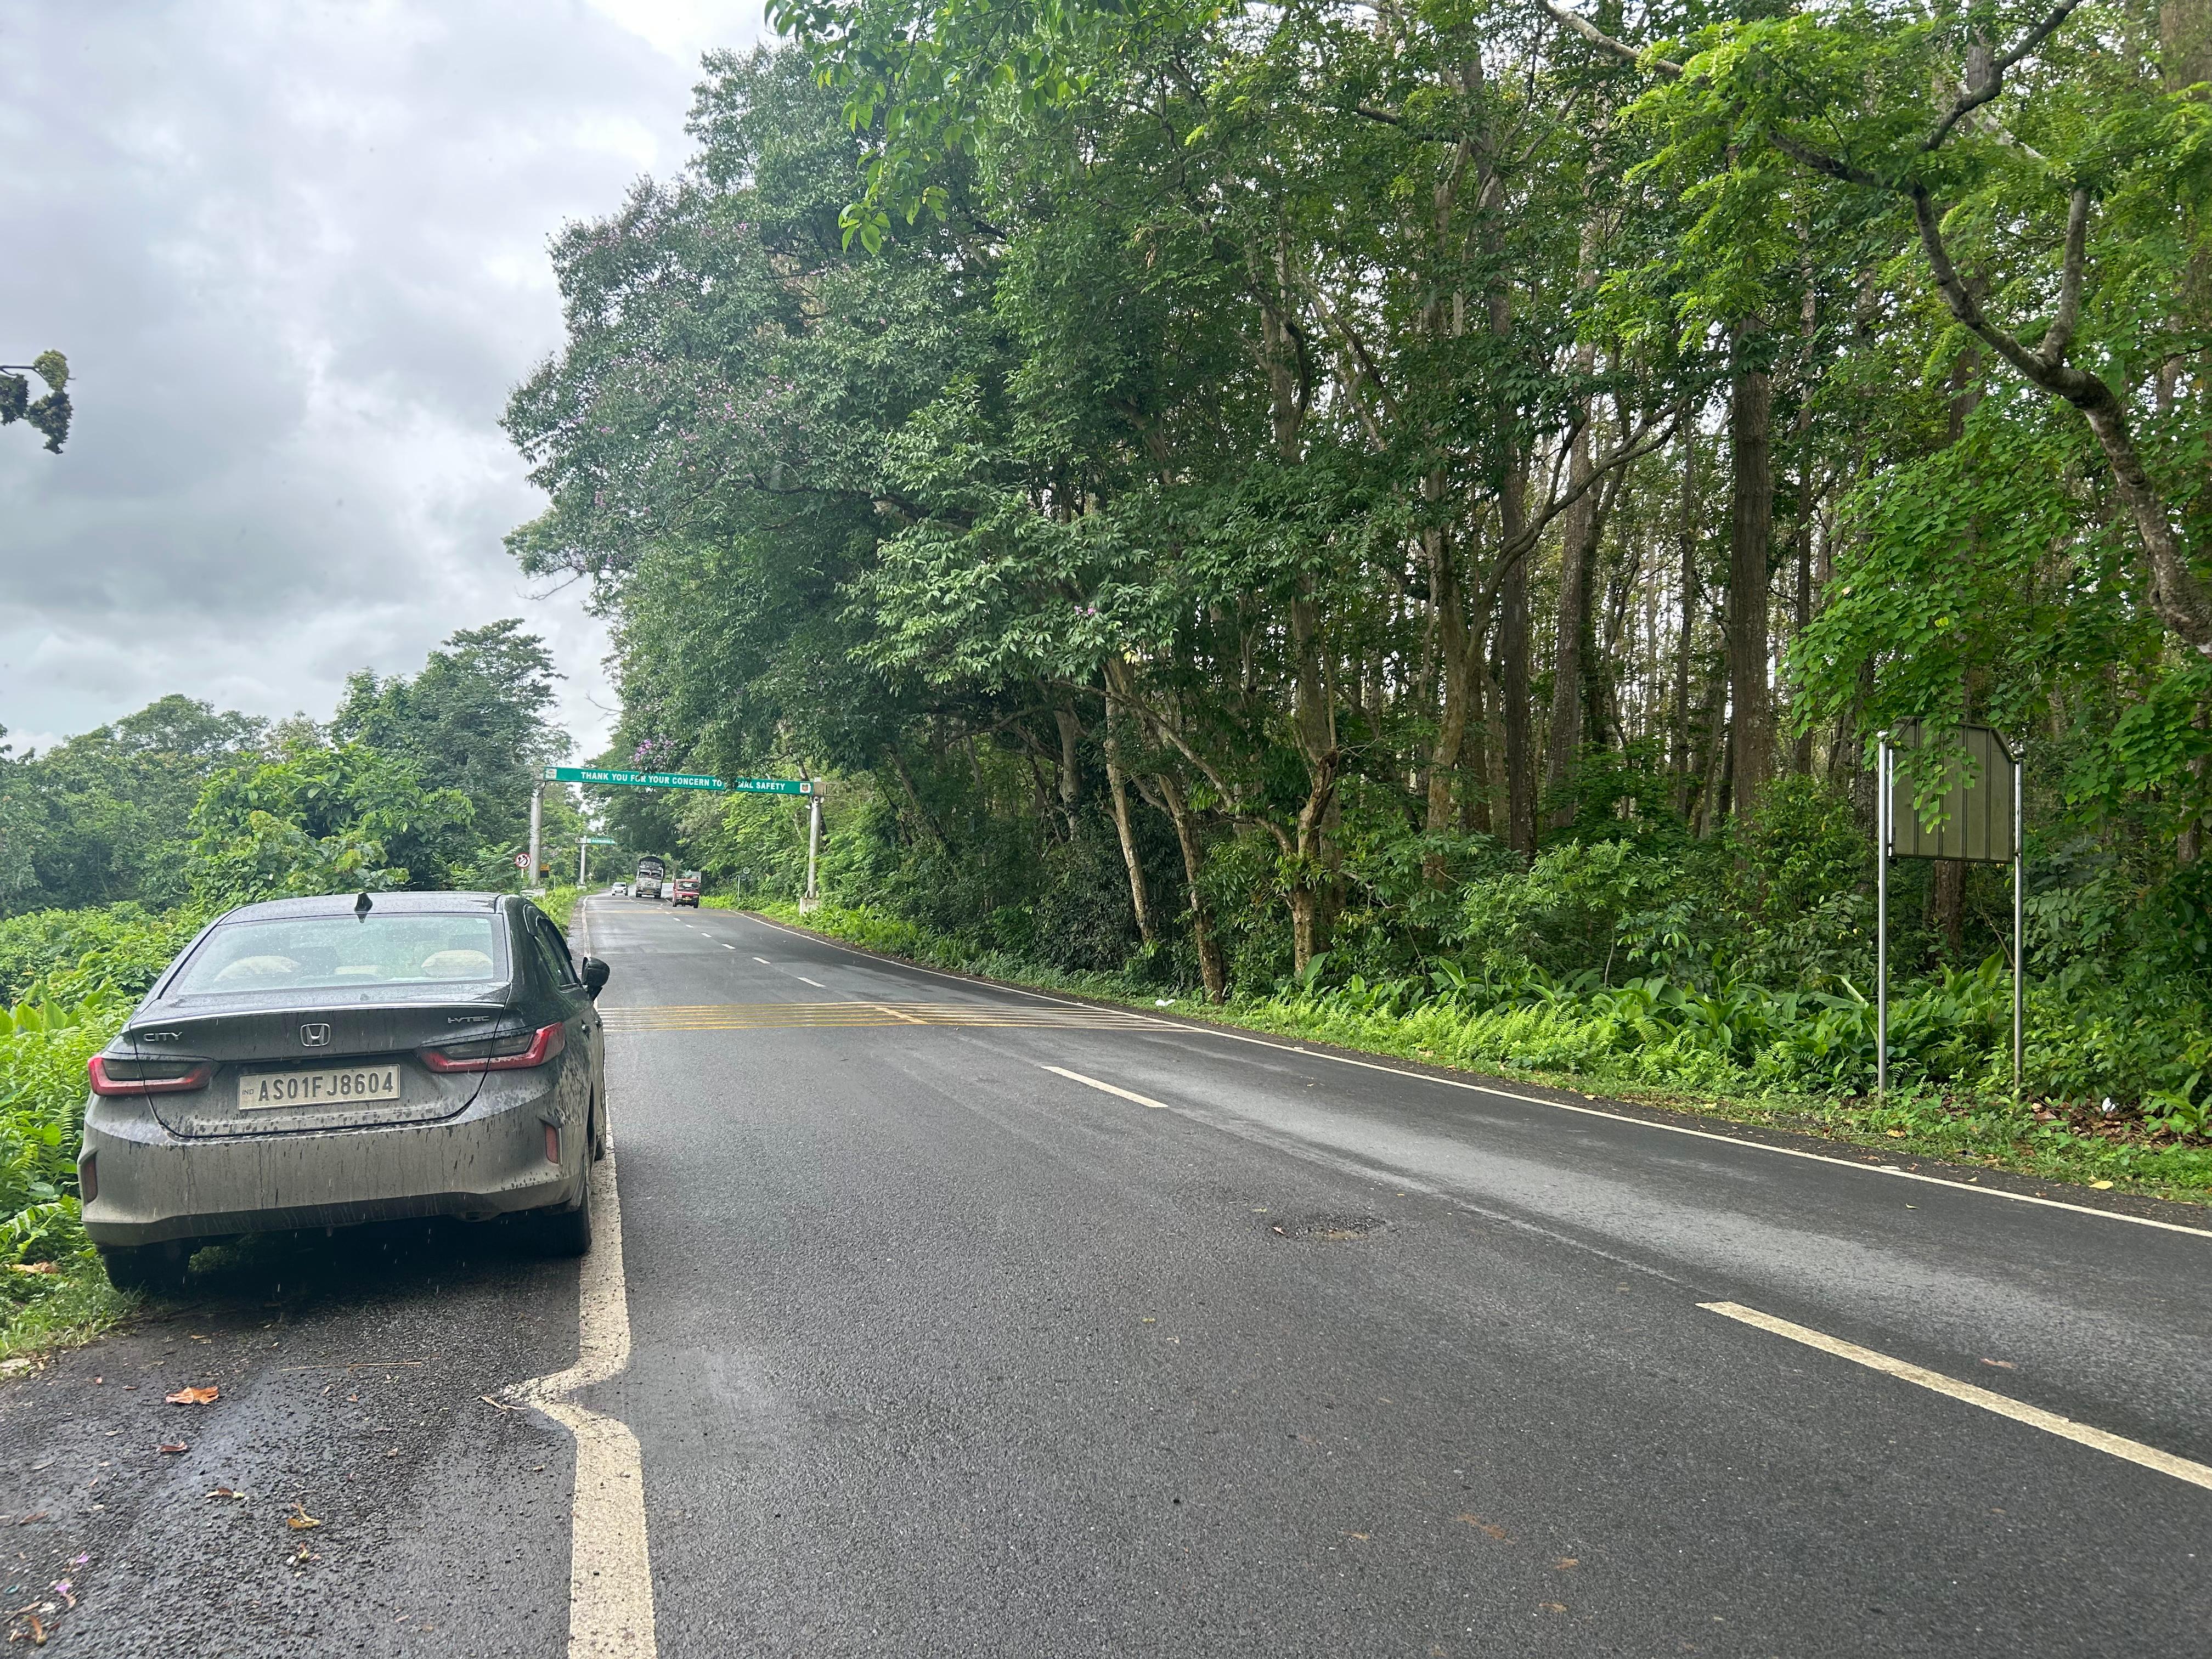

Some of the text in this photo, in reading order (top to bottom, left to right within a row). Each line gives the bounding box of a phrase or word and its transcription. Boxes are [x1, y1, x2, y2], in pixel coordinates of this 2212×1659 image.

[580, 772, 608, 781] THANK
[612, 773, 628, 781] YOU
[648, 775, 670, 785] YOUR
[672, 777, 709, 786] CONCERN
[755, 782, 786, 791] SAFETY
[143, 1031, 183, 1041] CITY
[258, 1071, 393, 1102] AS01FJ8604
